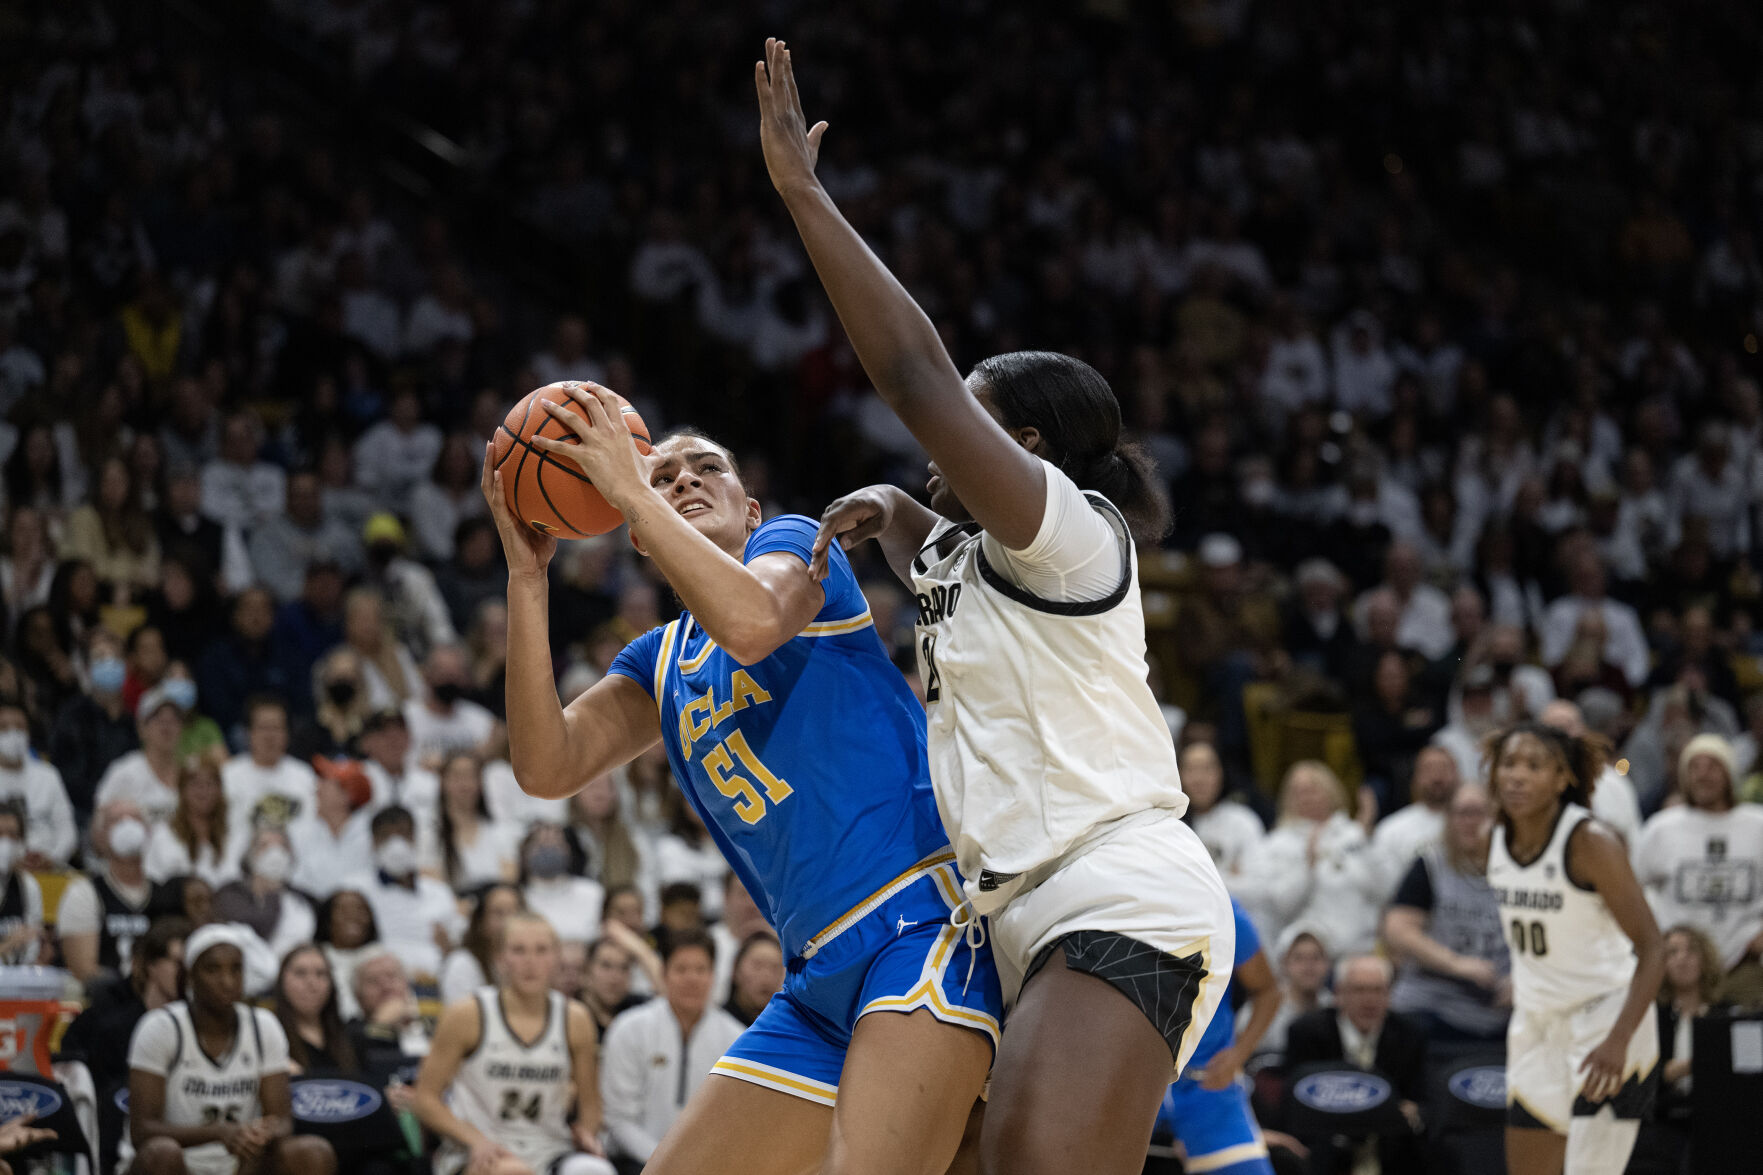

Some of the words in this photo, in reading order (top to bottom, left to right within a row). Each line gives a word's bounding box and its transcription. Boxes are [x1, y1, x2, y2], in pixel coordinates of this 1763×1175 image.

[915, 582, 962, 626] RADO
[679, 669, 773, 762] UCLA
[701, 727, 795, 825] 51
[1511, 918, 1548, 956] 00
[293, 1083, 362, 1117] Ford
[500, 1089, 542, 1121] 24
